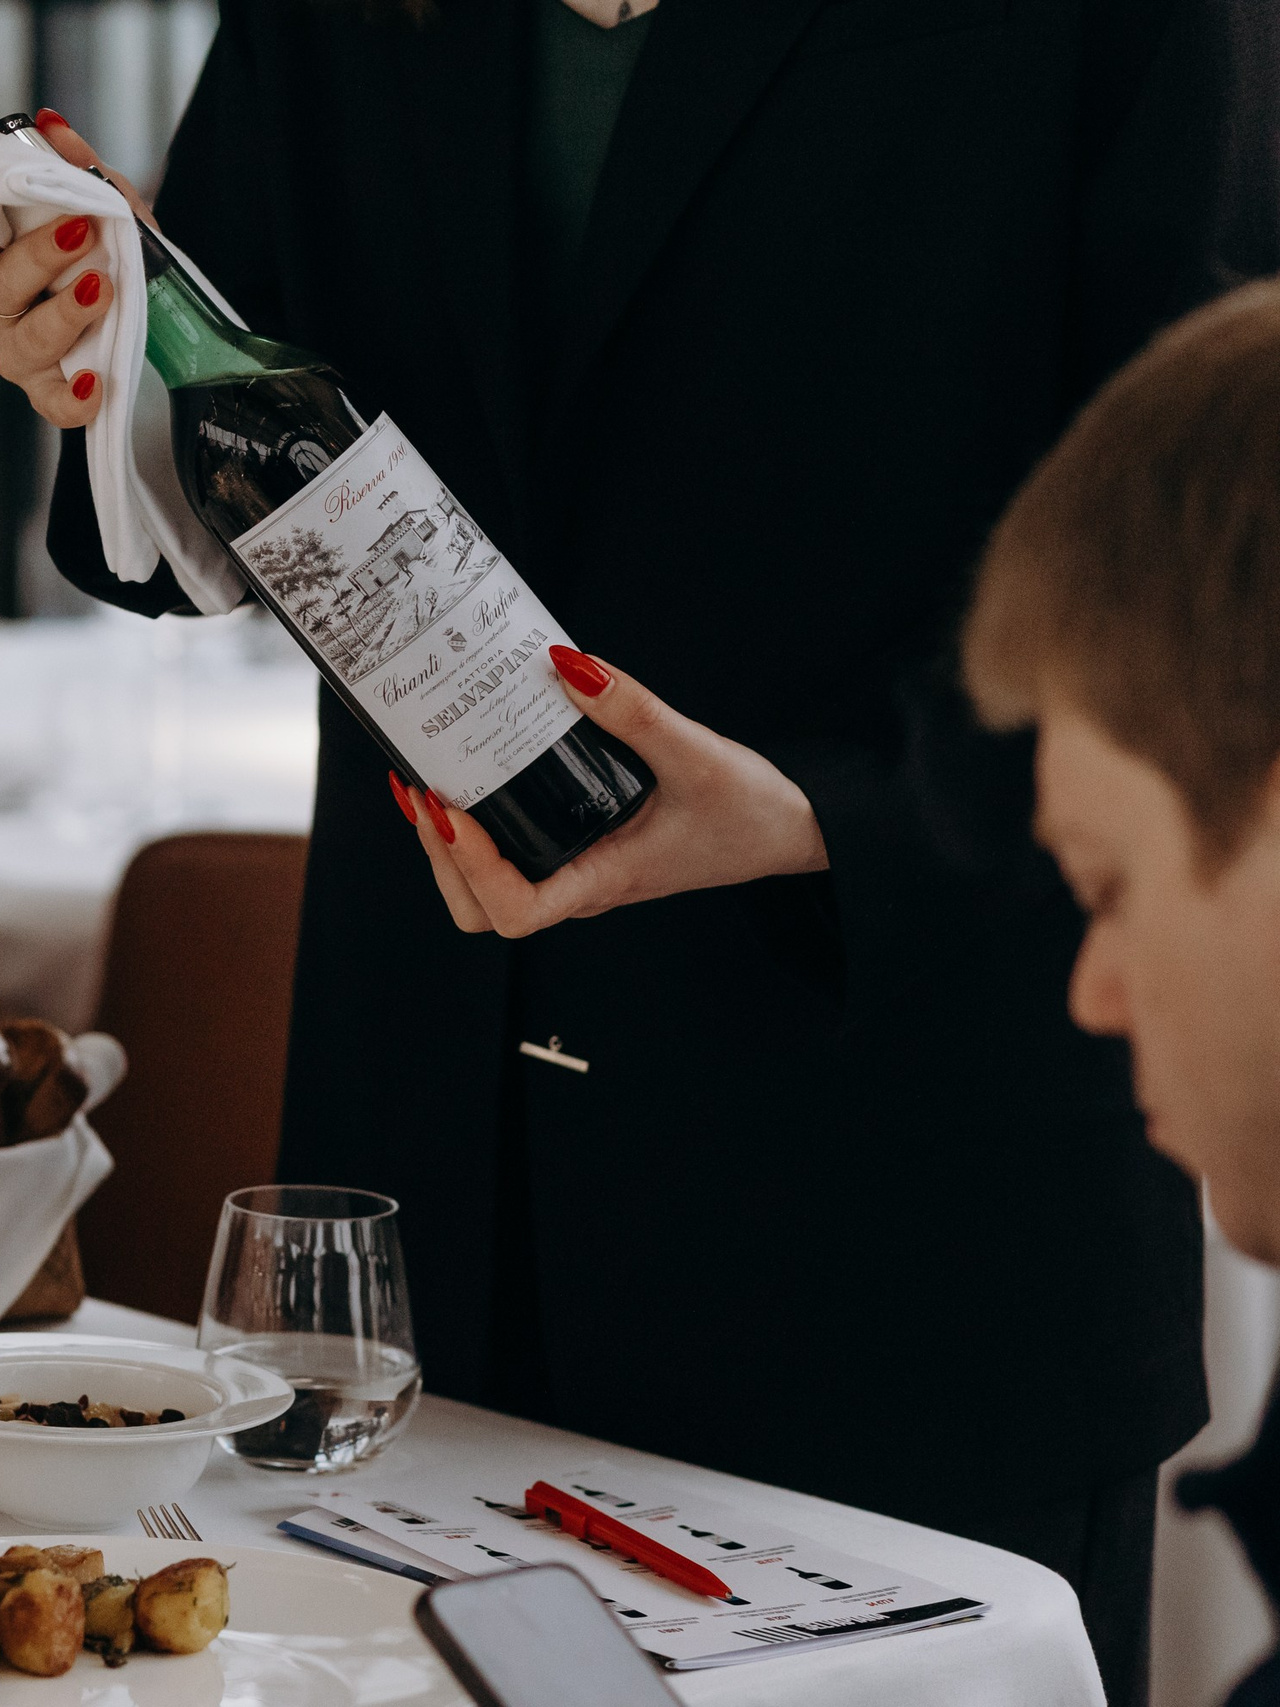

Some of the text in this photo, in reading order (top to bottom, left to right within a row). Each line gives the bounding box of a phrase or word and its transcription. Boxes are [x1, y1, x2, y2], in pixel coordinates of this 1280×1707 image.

[325, 469, 386, 523] Riserva
[374, 586, 519, 709] Chianti Rufina
[458, 649, 504, 689] FATTORIA
[421, 628, 548, 739] SELVAPIANA
[459, 725, 504, 762] Francesco
[497, 755, 513, 767] NELLE
[513, 739, 532, 756] CANTINE
